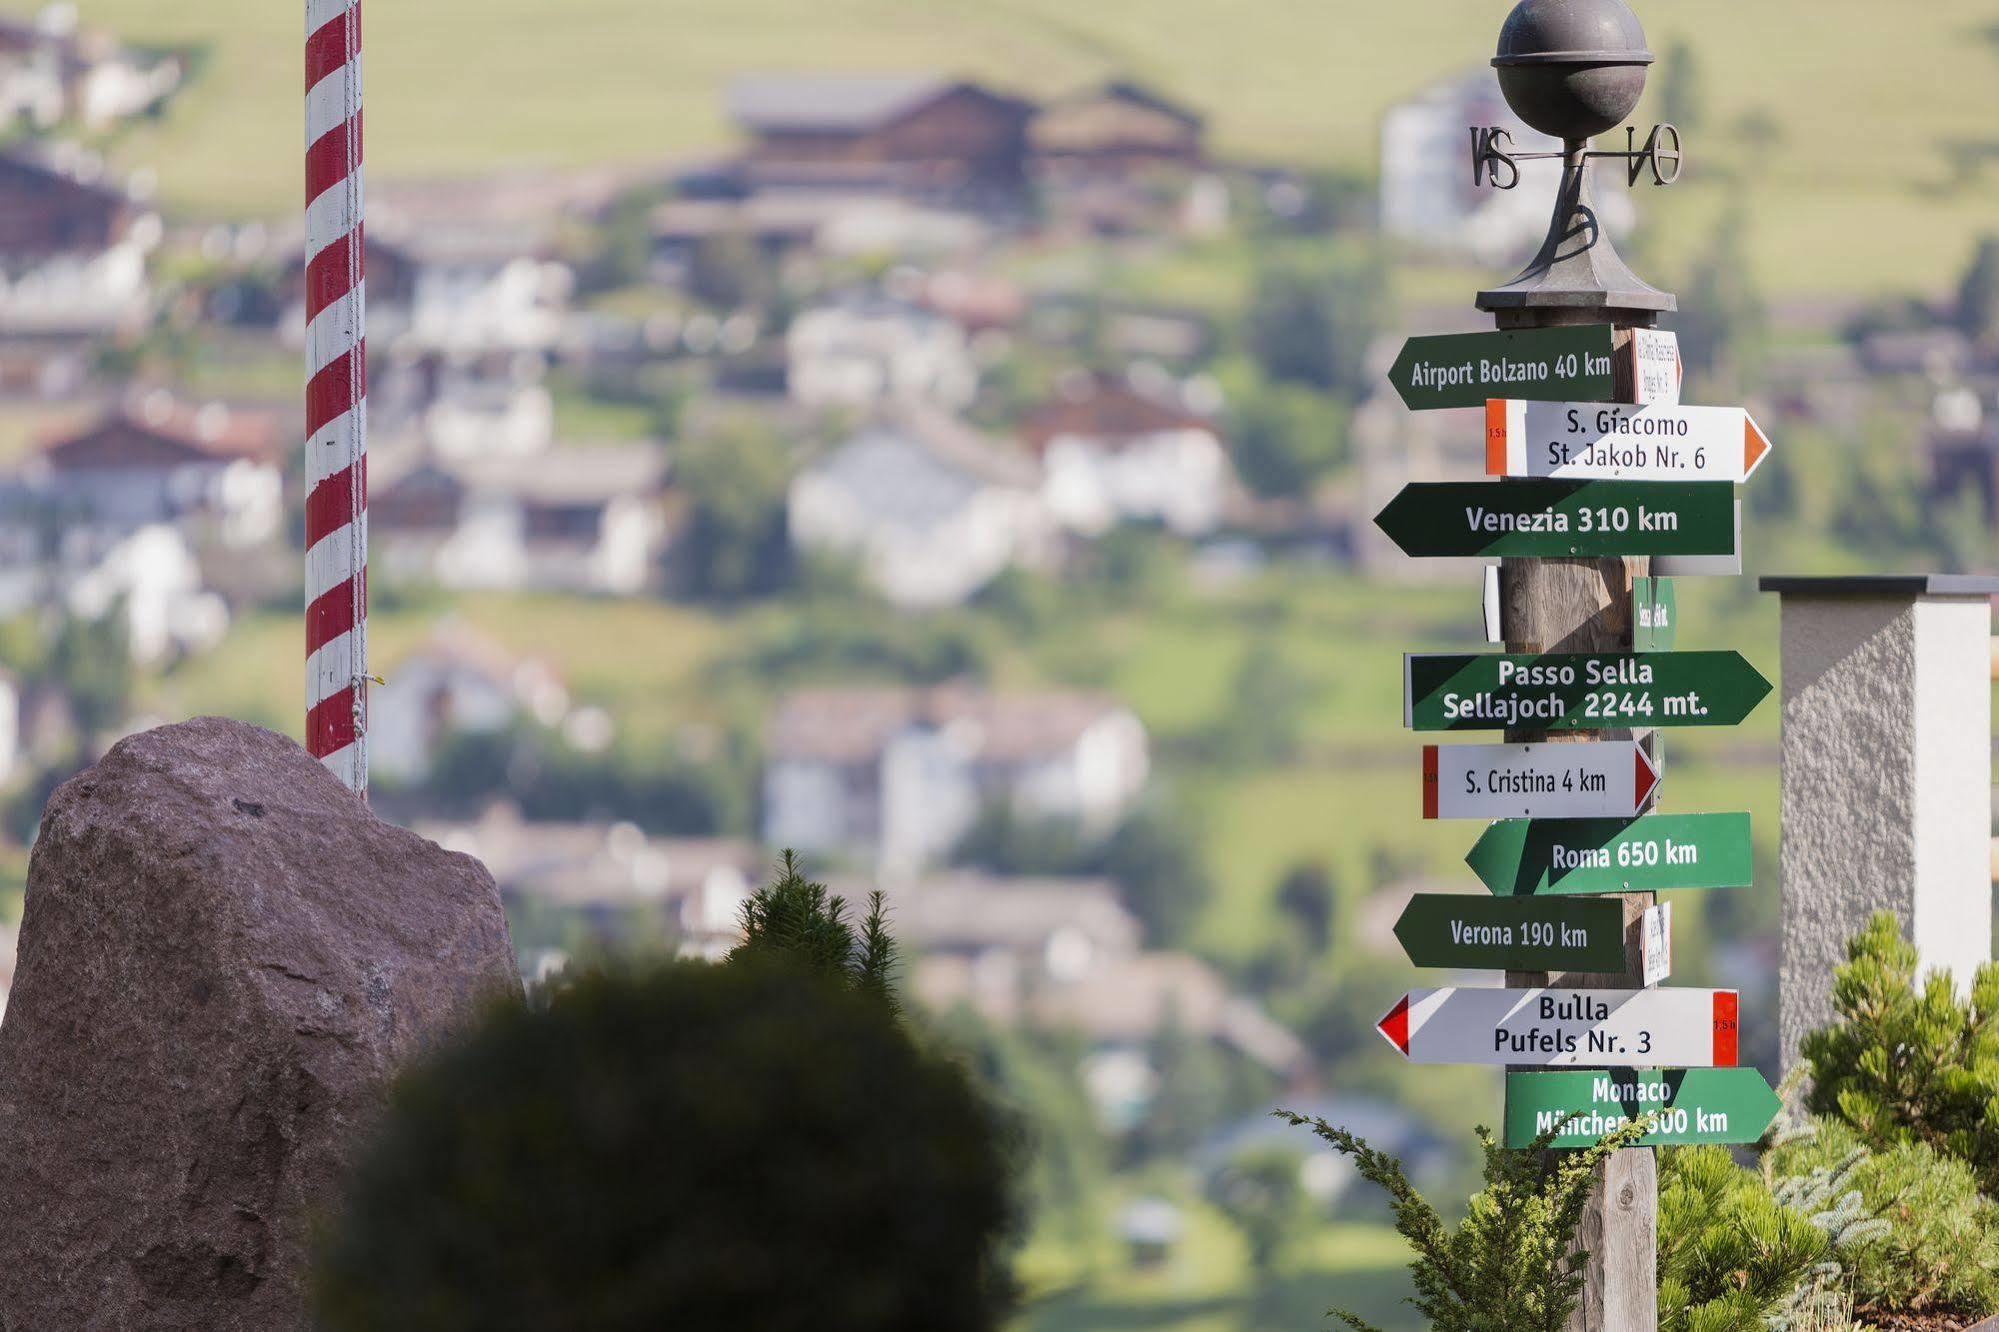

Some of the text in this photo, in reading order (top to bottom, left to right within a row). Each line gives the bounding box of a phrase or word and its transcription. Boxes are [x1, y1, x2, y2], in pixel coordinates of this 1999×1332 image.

[1411, 351, 1611, 391] Airport Bolzano 40 km
[1567, 408, 1688, 437] S. Giacomo
[1549, 441, 1706, 469] St. Jakob Nr. 6
[1466, 505, 1678, 532] Venezia 310 km
[1499, 658, 1653, 686] Passo Sella
[1443, 691, 1709, 725] Sellajoch 2244 mt.
[1465, 770, 1482, 794] S.
[1488, 768, 1556, 793] Cristina
[1562, 769, 1573, 793] 4
[1579, 768, 1606, 792] km
[1552, 838, 1698, 868] Roma 650 km
[1450, 919, 1588, 947] Verona 190 km
[1539, 995, 1609, 1021] Bulla
[1494, 1028, 1652, 1054] Pufels Nr. 3
[1592, 1077, 1671, 1103] Monaco
[1696, 1107, 1728, 1133] km
